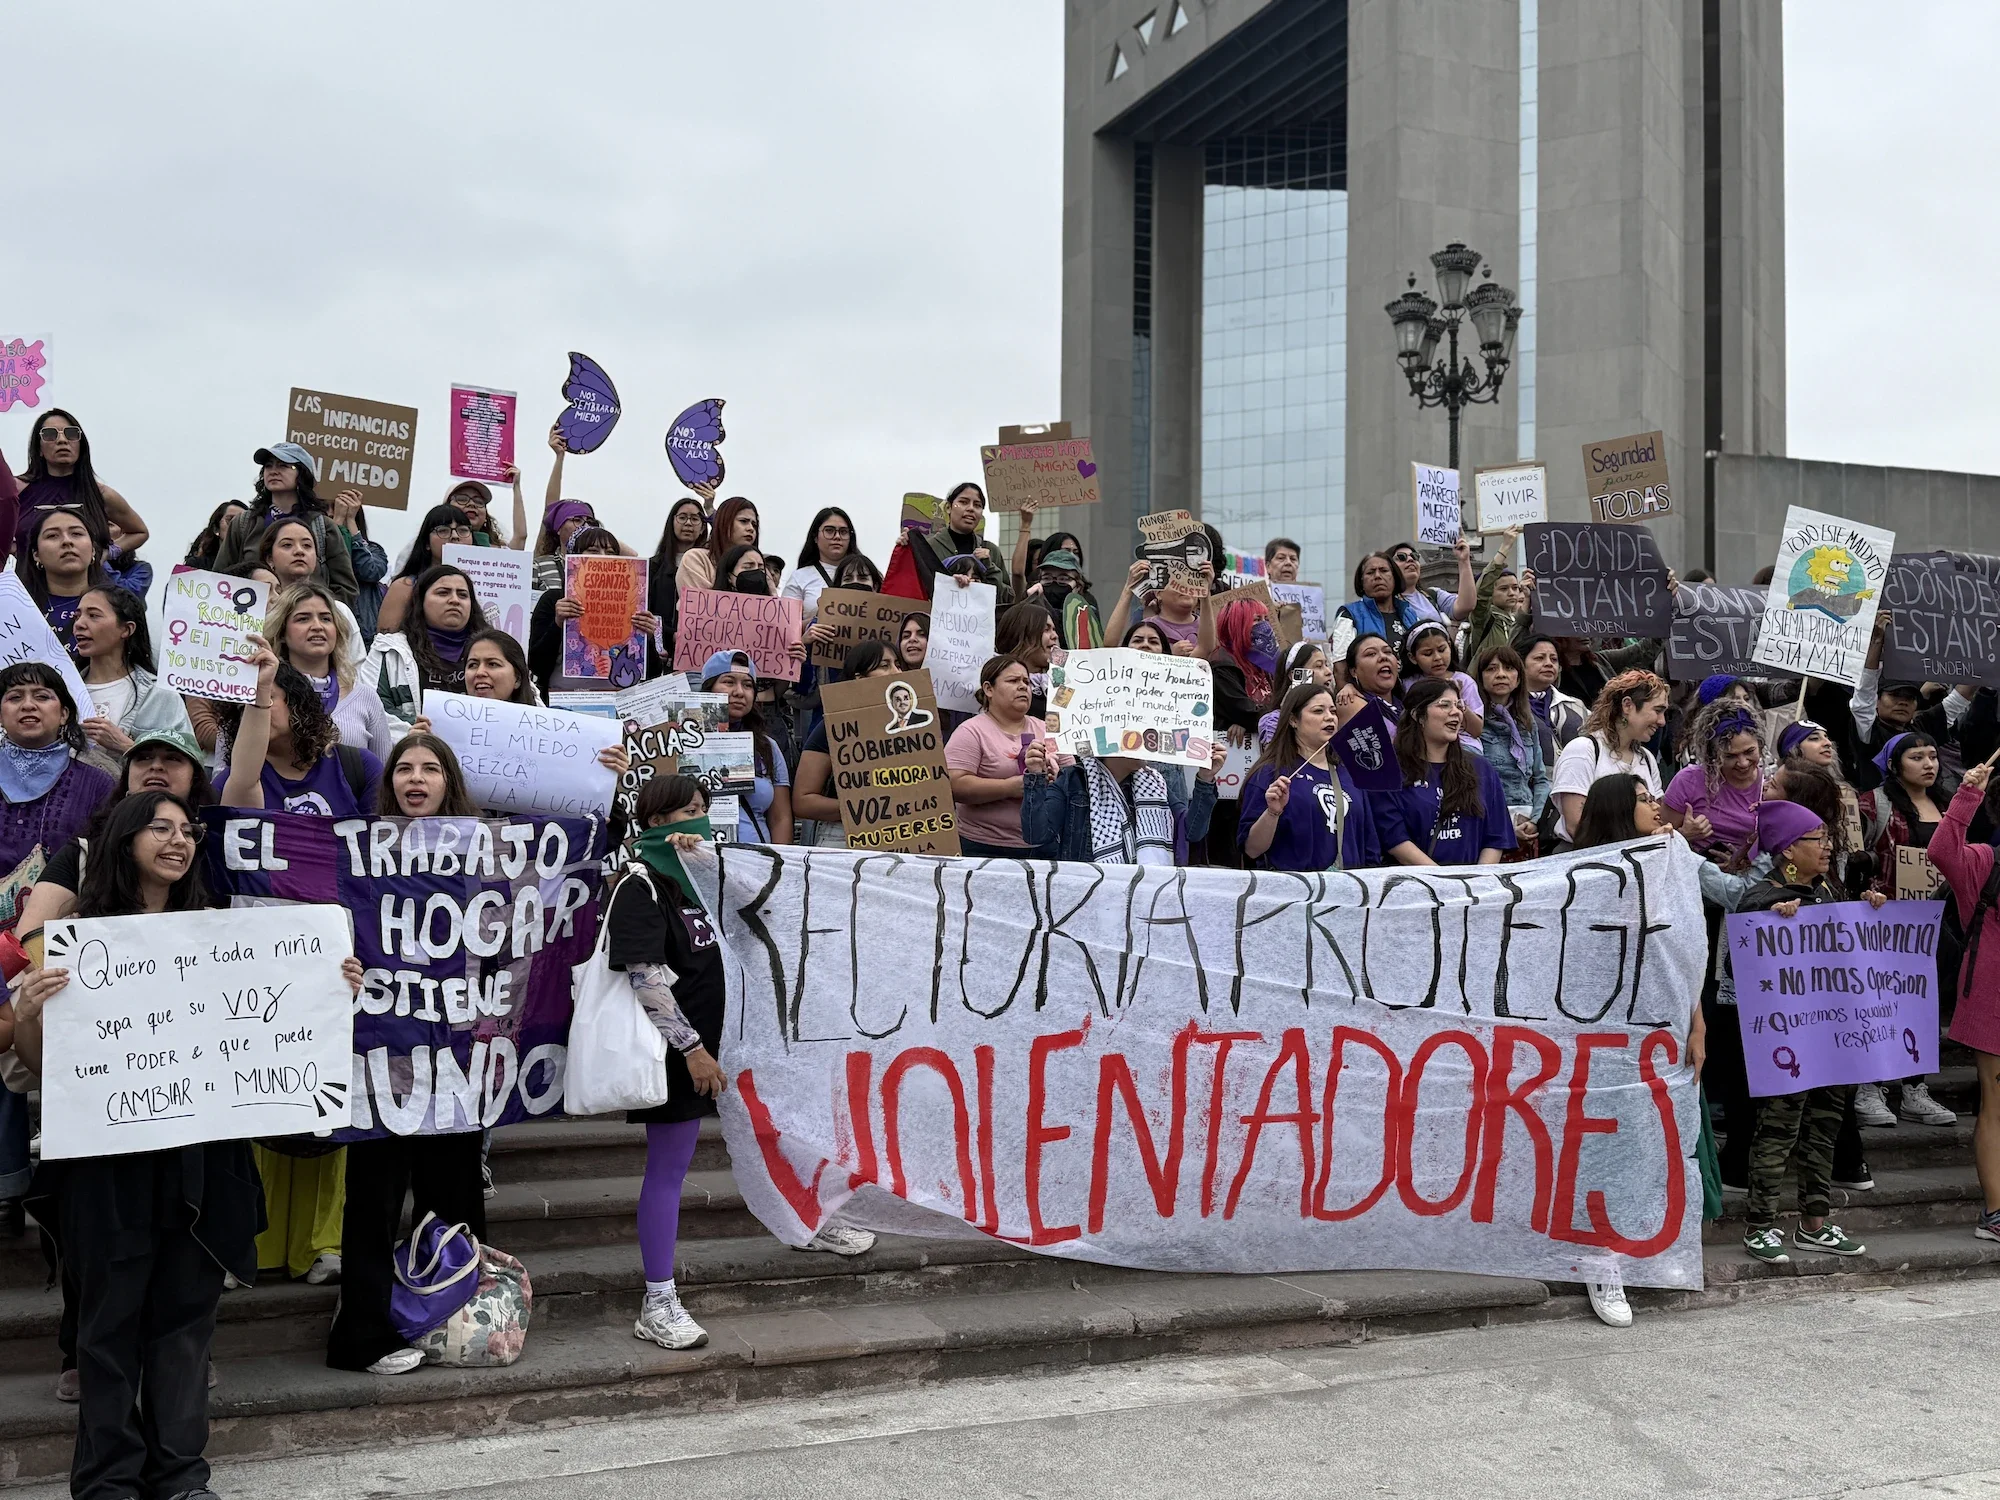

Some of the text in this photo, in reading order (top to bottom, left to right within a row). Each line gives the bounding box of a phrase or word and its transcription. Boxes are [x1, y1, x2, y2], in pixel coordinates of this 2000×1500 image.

[571, 398, 621, 415] SEMBRARON
[579, 390, 597, 402] NOS
[294, 395, 410, 440] LAS INFANCIAS
[574, 411, 601, 423] MIEDO
[667, 436, 713, 451] CRECIERON
[674, 426, 696, 439] NOS
[290, 429, 410, 461] merecen crecer
[686, 450, 709, 461] ALAS
[1591, 437, 1656, 473] Seguridad
[328, 459, 399, 490] MIEDO
[1033, 459, 1077, 473] AMIGAS
[1427, 470, 1445, 485] NO
[1602, 471, 1650, 491] para
[1494, 488, 1538, 506] VIVIR
[1593, 483, 1671, 522] TODAS
[1139, 511, 1190, 528] AUNQUE NO
[1423, 502, 1460, 523] MUERTAS
[1508, 511, 1538, 522] miedo
[1148, 523, 1204, 541] DENUNCIADO
[1433, 520, 1447, 531] LAS
[1533, 525, 1659, 575] ¿DÓNDE
[1781, 523, 1885, 581] TODO ESTE MALDITO
[177, 578, 211, 600] NO
[583, 573, 631, 590] ESPANTAS
[1169, 580, 1206, 597] HICISTE
[1187, 578, 1205, 588] QUE
[1884, 566, 1999, 618] ¿DÓNDE
[685, 589, 790, 625] EDUCACIÓN
[950, 589, 968, 609] TU
[1536, 572, 1657, 619] ESTÁN?
[197, 601, 264, 633] ROMPAN
[824, 602, 868, 620] ¿QUÉ
[937, 611, 980, 634] ABUSO
[684, 616, 787, 651] SEGURA, SIN
[832, 624, 892, 642] UN PAÍS
[1571, 620, 1636, 634] FUNDENL
[1762, 607, 1867, 655] SISTEMA PATRIARCAL
[1891, 607, 1998, 663] ESTÁN?
[947, 637, 971, 648] VENIA
[165, 648, 239, 677] YO VISTO
[1762, 637, 1853, 679] ESTÁ MAL
[1921, 657, 1981, 679] FUNDENL
[205, 678, 258, 697] QUIERO
[1142, 670, 1160, 687] que
[1106, 684, 1131, 695] con
[1135, 686, 1165, 698] poder
[1125, 698, 1136, 708] el
[443, 699, 581, 734] QUE ARDA
[1071, 713, 1092, 726] No
[1153, 715, 1169, 728] que
[470, 727, 578, 758] EL MIEDO
[831, 720, 860, 743] UN
[1058, 728, 1089, 744] Tan
[837, 731, 937, 766] GOBIERNO
[461, 754, 528, 779] REZCA
[838, 765, 951, 790] QUE IGNORA LA
[488, 782, 516, 806] LA
[533, 790, 606, 817] LUCHA
[846, 795, 939, 827] VOZ DE LAS
[849, 813, 955, 849] MUJERES
[223, 818, 289, 871] EL
[333, 820, 570, 881] TRABAJO
[1899, 849, 1913, 865] EL
[380, 877, 590, 960] HOGAR
[1229, 842, 1674, 1028] PROTEGE
[1799, 916, 1854, 953] más
[78, 934, 322, 990] Quiero que toda niña
[1810, 966, 1865, 995] mas
[146, 1013, 174, 1036] que
[189, 1001, 206, 1016] su
[222, 982, 293, 1023] VOZ
[74, 1062, 110, 1080] tiene
[126, 1049, 179, 1070] PODER
[219, 1038, 251, 1062] que
[274, 1027, 313, 1053] puede
[106, 1061, 319, 1122] CAMBIAR EL MUNDO
